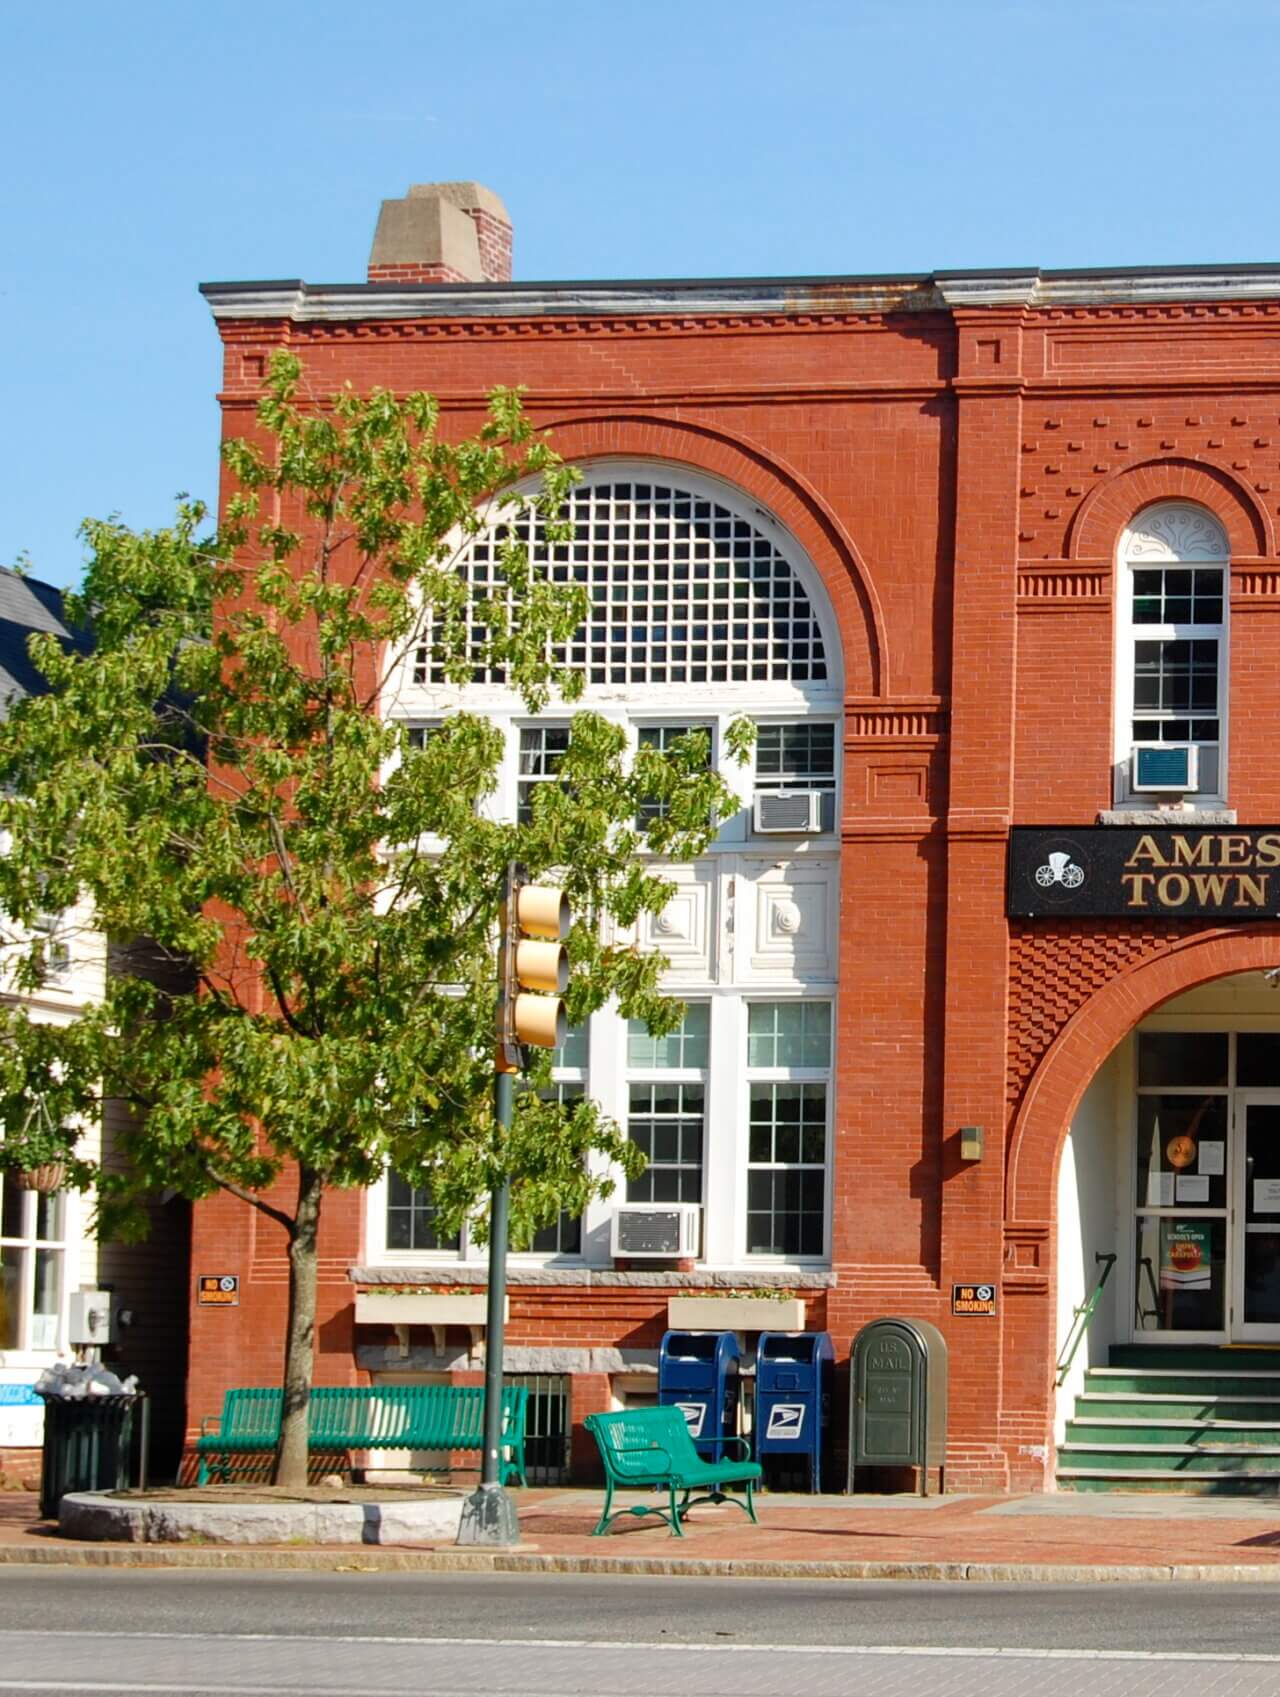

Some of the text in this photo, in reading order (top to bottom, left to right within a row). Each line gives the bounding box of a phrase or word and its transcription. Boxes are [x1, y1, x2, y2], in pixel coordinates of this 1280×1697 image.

[1121, 873, 1270, 907] TOWN
[960, 1288, 974, 1300] NO
[955, 1301, 994, 1312] SMOKING
[872, 1357, 907, 1369] MAIL
